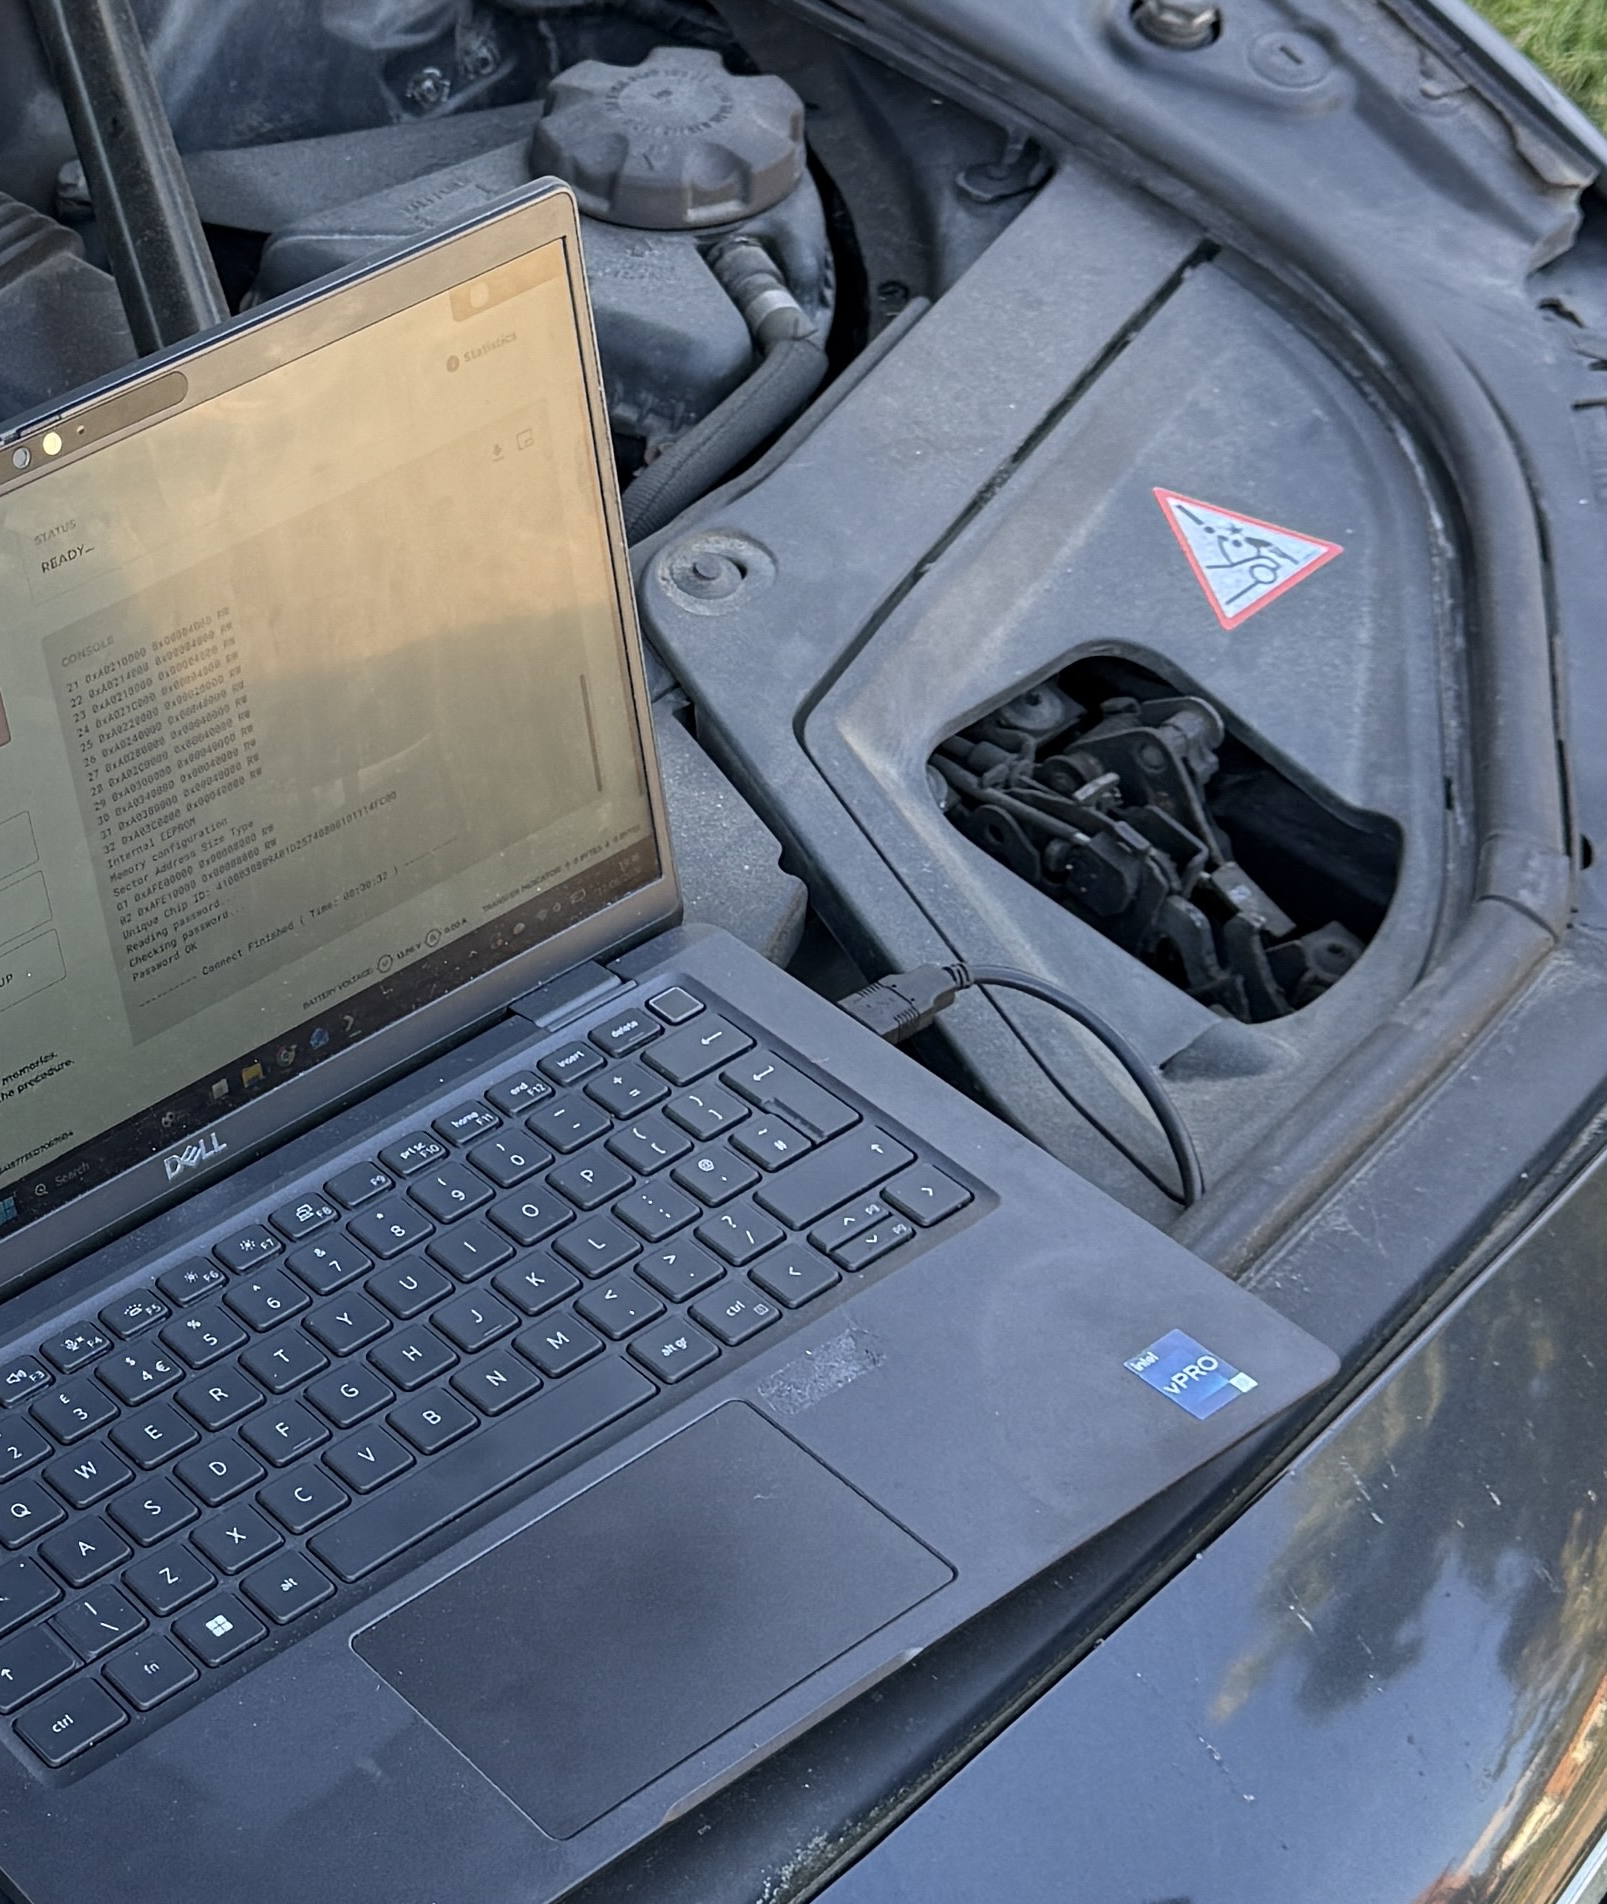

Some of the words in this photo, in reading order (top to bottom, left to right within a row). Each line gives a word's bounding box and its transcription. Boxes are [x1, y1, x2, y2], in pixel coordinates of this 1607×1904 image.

[33, 517, 77, 546] STATUS
[60, 633, 114, 669] CONSOLE
[112, 872, 149, 899] Sector
[154, 847, 196, 878] Address
[200, 832, 225, 853] Size
[230, 817, 254, 838] Type
[201, 946, 243, 978] Connect
[247, 919, 294, 953] Finished
[132, 950, 180, 983] Password
[184, 940, 198, 955] OK
[611, 1020, 639, 1038] delete
[0, 1046, 58, 1087] memories.
[556, 1050, 585, 1068] insert
[15, 1052, 74, 1095] procedure.
[510, 1082, 529, 1095] end
[526, 1083, 546, 1097] F12
[451, 1111, 479, 1128] home
[475, 1113, 494, 1126] F11
[163, 1132, 228, 1180] DELL
[419, 1144, 440, 1158] F10
[54, 1159, 90, 1188] Search
[370, 1175, 386, 1186] F9
[579, 1169, 594, 1183] P
[315, 1206, 332, 1218] F8
[521, 1204, 539, 1217] O
[260, 1238, 274, 1250] F7
[587, 1238, 606, 1250] L
[202, 1270, 219, 1282] F6
[398, 1275, 418, 1290] U
[525, 1271, 545, 1287] K
[145, 1304, 161, 1316] F5
[726, 1300, 746, 1317] ctrl
[335, 1312, 353, 1325] Y
[471, 1309, 483, 1324] J
[86, 1336, 103, 1348] F4
[546, 1331, 570, 1350] M
[661, 1344, 678, 1357] alt
[674, 1337, 687, 1350] gr
[273, 1348, 290, 1363] T
[402, 1345, 423, 1362] H
[1130, 1351, 1159, 1372] intel
[28, 1370, 45, 1382] F3
[485, 1370, 507, 1386] N
[1163, 1355, 1218, 1394] vPRO
[208, 1387, 229, 1402] R
[340, 1383, 359, 1398] G
[422, 1410, 442, 1425] B
[144, 1424, 163, 1440] E
[275, 1422, 289, 1437] F
[357, 1447, 375, 1462] V
[74, 1461, 97, 1479] W
[208, 1461, 227, 1476] D
[294, 1487, 313, 1502] C
[10, 1503, 32, 1518] Q
[143, 1500, 161, 1515] S
[225, 1527, 247, 1544] X
[78, 1541, 96, 1556] A
[158, 1567, 179, 1584] Z
[280, 1577, 298, 1591] alt
[143, 1663, 160, 1675] fn
[52, 1714, 74, 1733] ctrl
